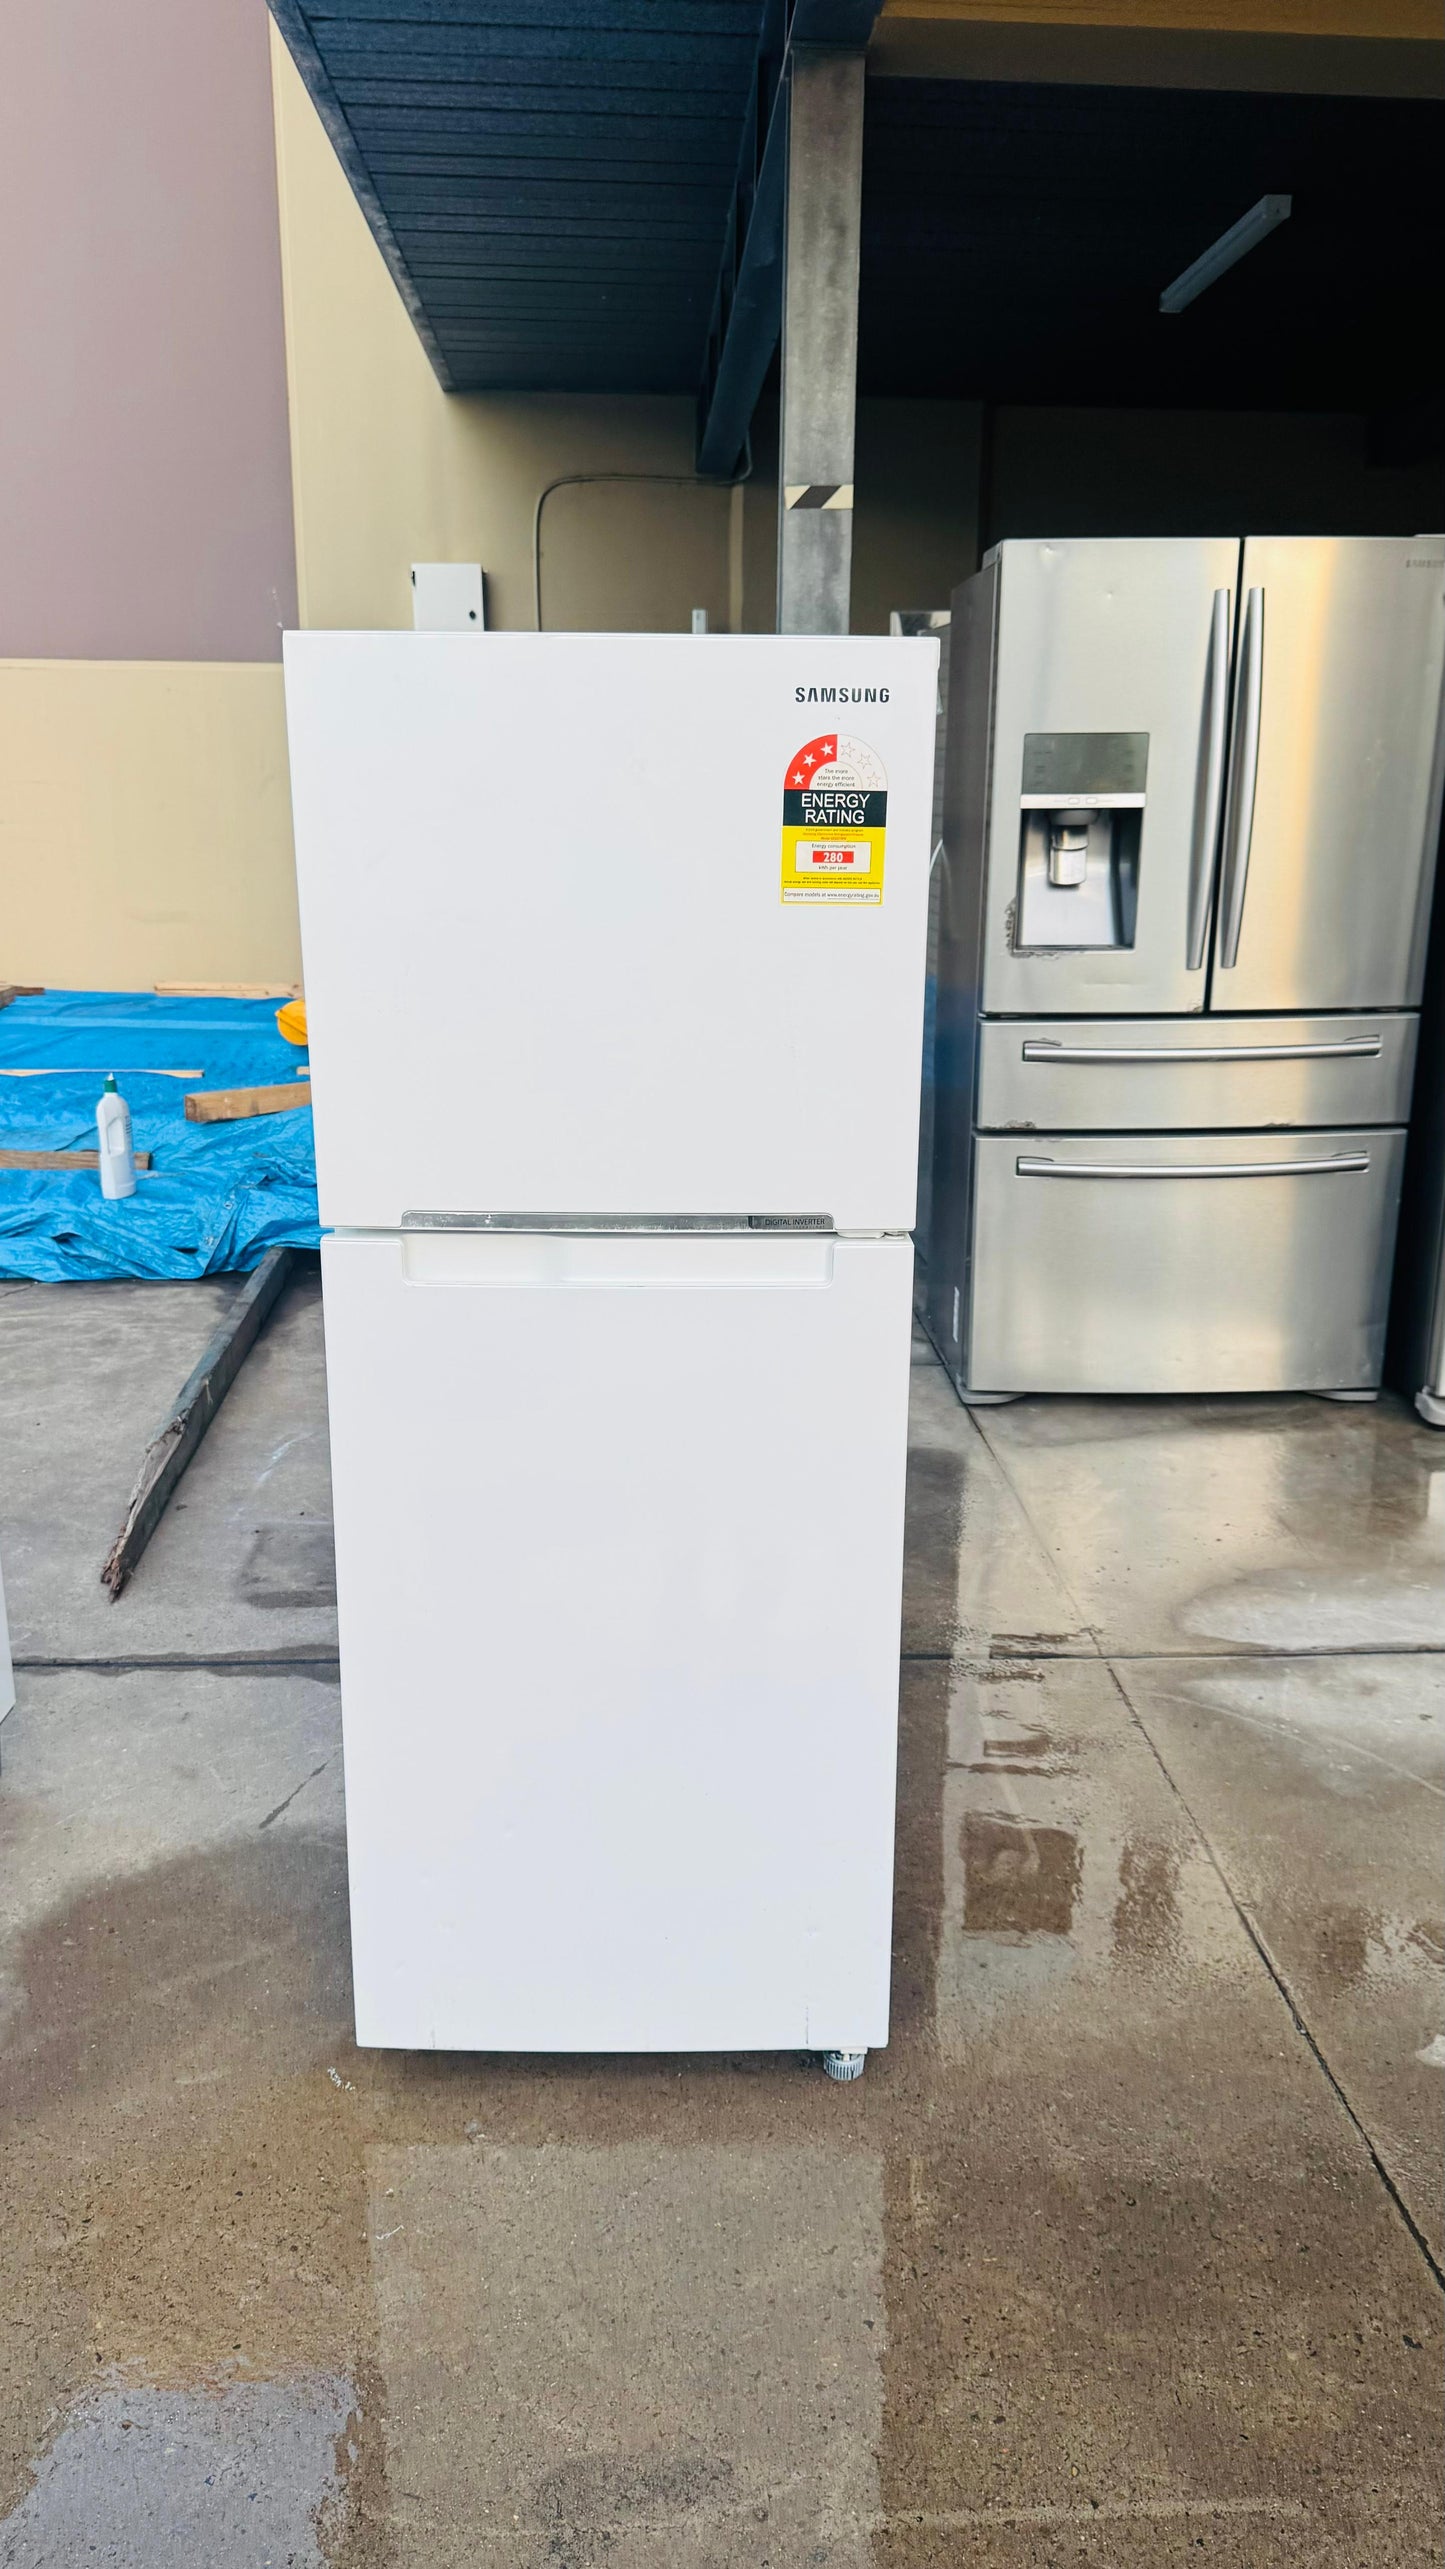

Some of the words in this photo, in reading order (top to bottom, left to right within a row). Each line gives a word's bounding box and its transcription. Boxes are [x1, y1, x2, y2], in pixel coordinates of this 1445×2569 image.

[795, 687, 890, 703] SAMSUNG
[801, 792, 870, 808] ENERGY
[805, 809, 865, 824] RATING
[823, 852, 844, 863] 280
[765, 1218, 791, 1226] DIGITAL
[792, 1217, 825, 1226] INVERTER
